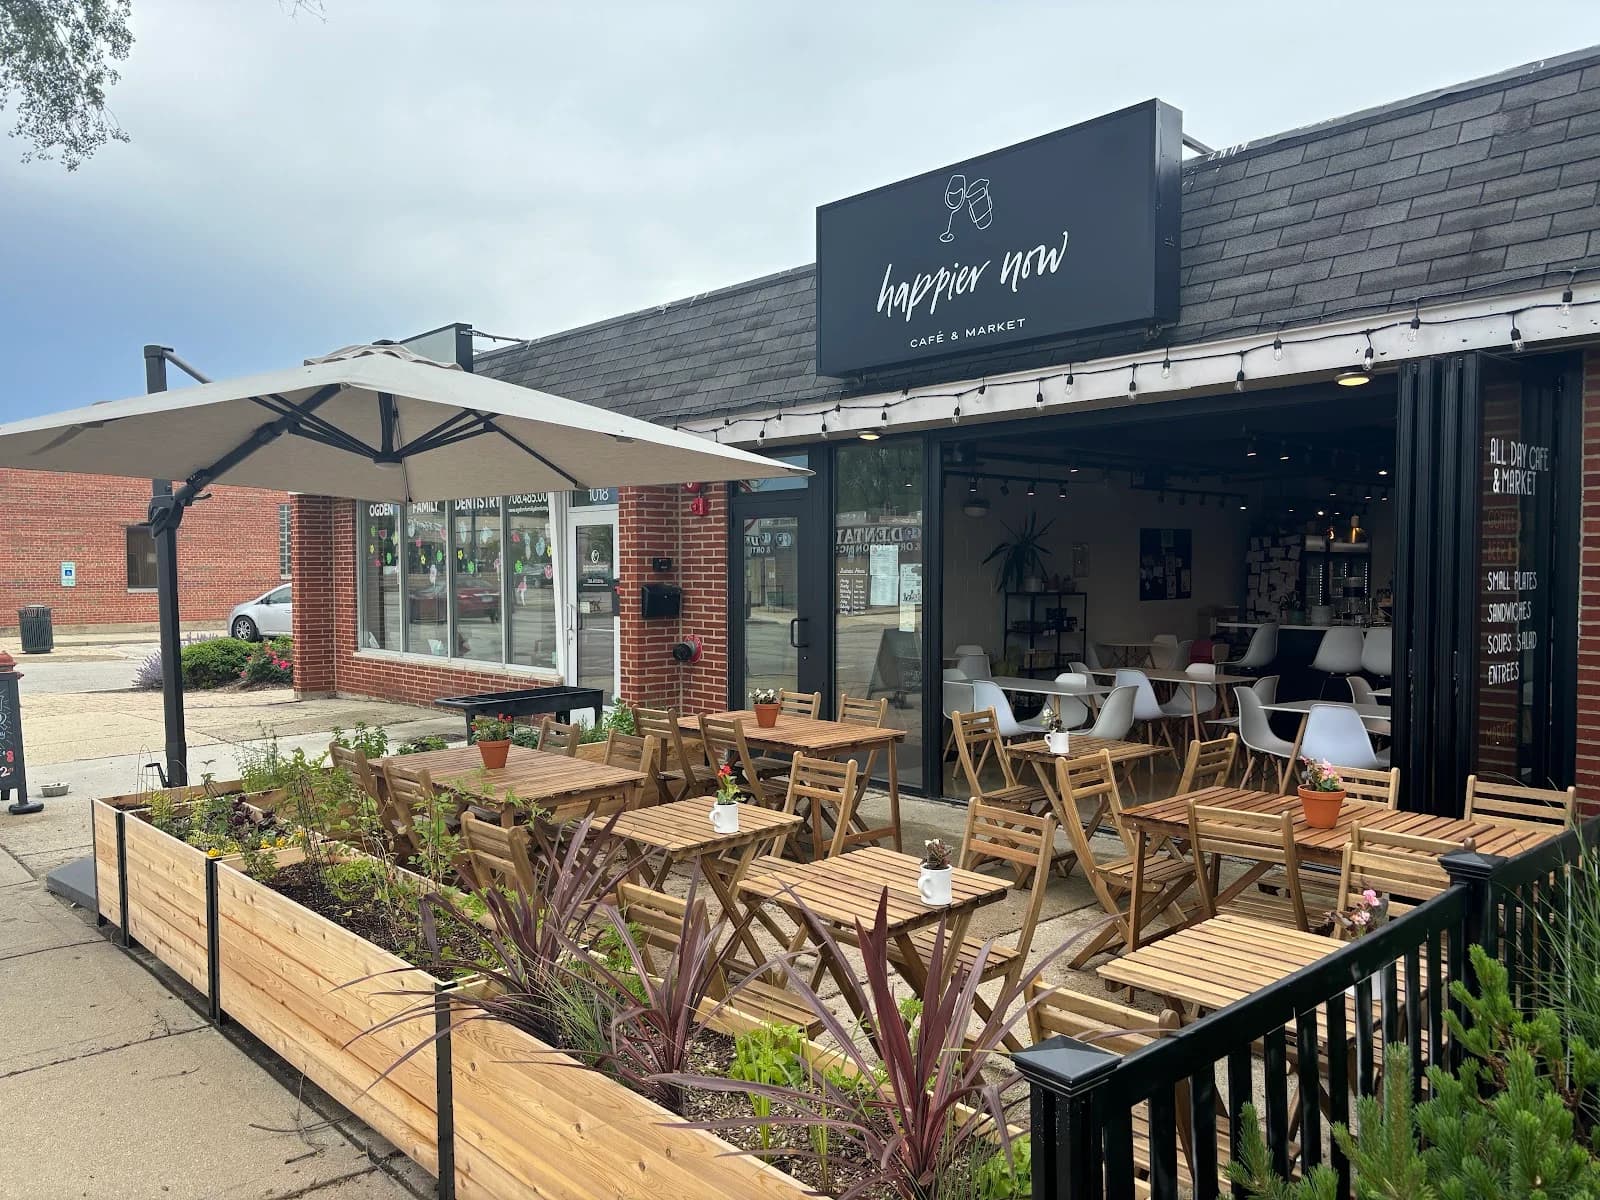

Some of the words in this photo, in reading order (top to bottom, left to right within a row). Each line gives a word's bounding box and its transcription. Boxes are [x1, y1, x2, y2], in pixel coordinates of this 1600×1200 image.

[876, 260, 991, 322] happier
[1000, 231, 1068, 292] now
[910, 330, 945, 348] CAFÉ
[950, 331, 959, 341] &
[965, 318, 1026, 338] MARKET
[1490, 438, 1507, 466] ALL
[1510, 441, 1528, 469] DAY
[1528, 447, 1549, 472] CAFE
[1492, 468, 1500, 494] &
[1501, 471, 1537, 496] MARKET
[369, 503, 394, 517] OGDEN
[412, 501, 438, 514] FAMILY
[454, 496, 500, 511] DENTISTRY
[588, 488, 609, 502] 1018
[1487, 571, 1510, 591] SMALL
[1514, 571, 1537, 590] PLATES
[1487, 601, 1532, 623] SANDWICHES
[1487, 633, 1512, 654] SOUPS
[1517, 631, 1537, 651] SALAD
[1488, 661, 1520, 685] ENTREES
